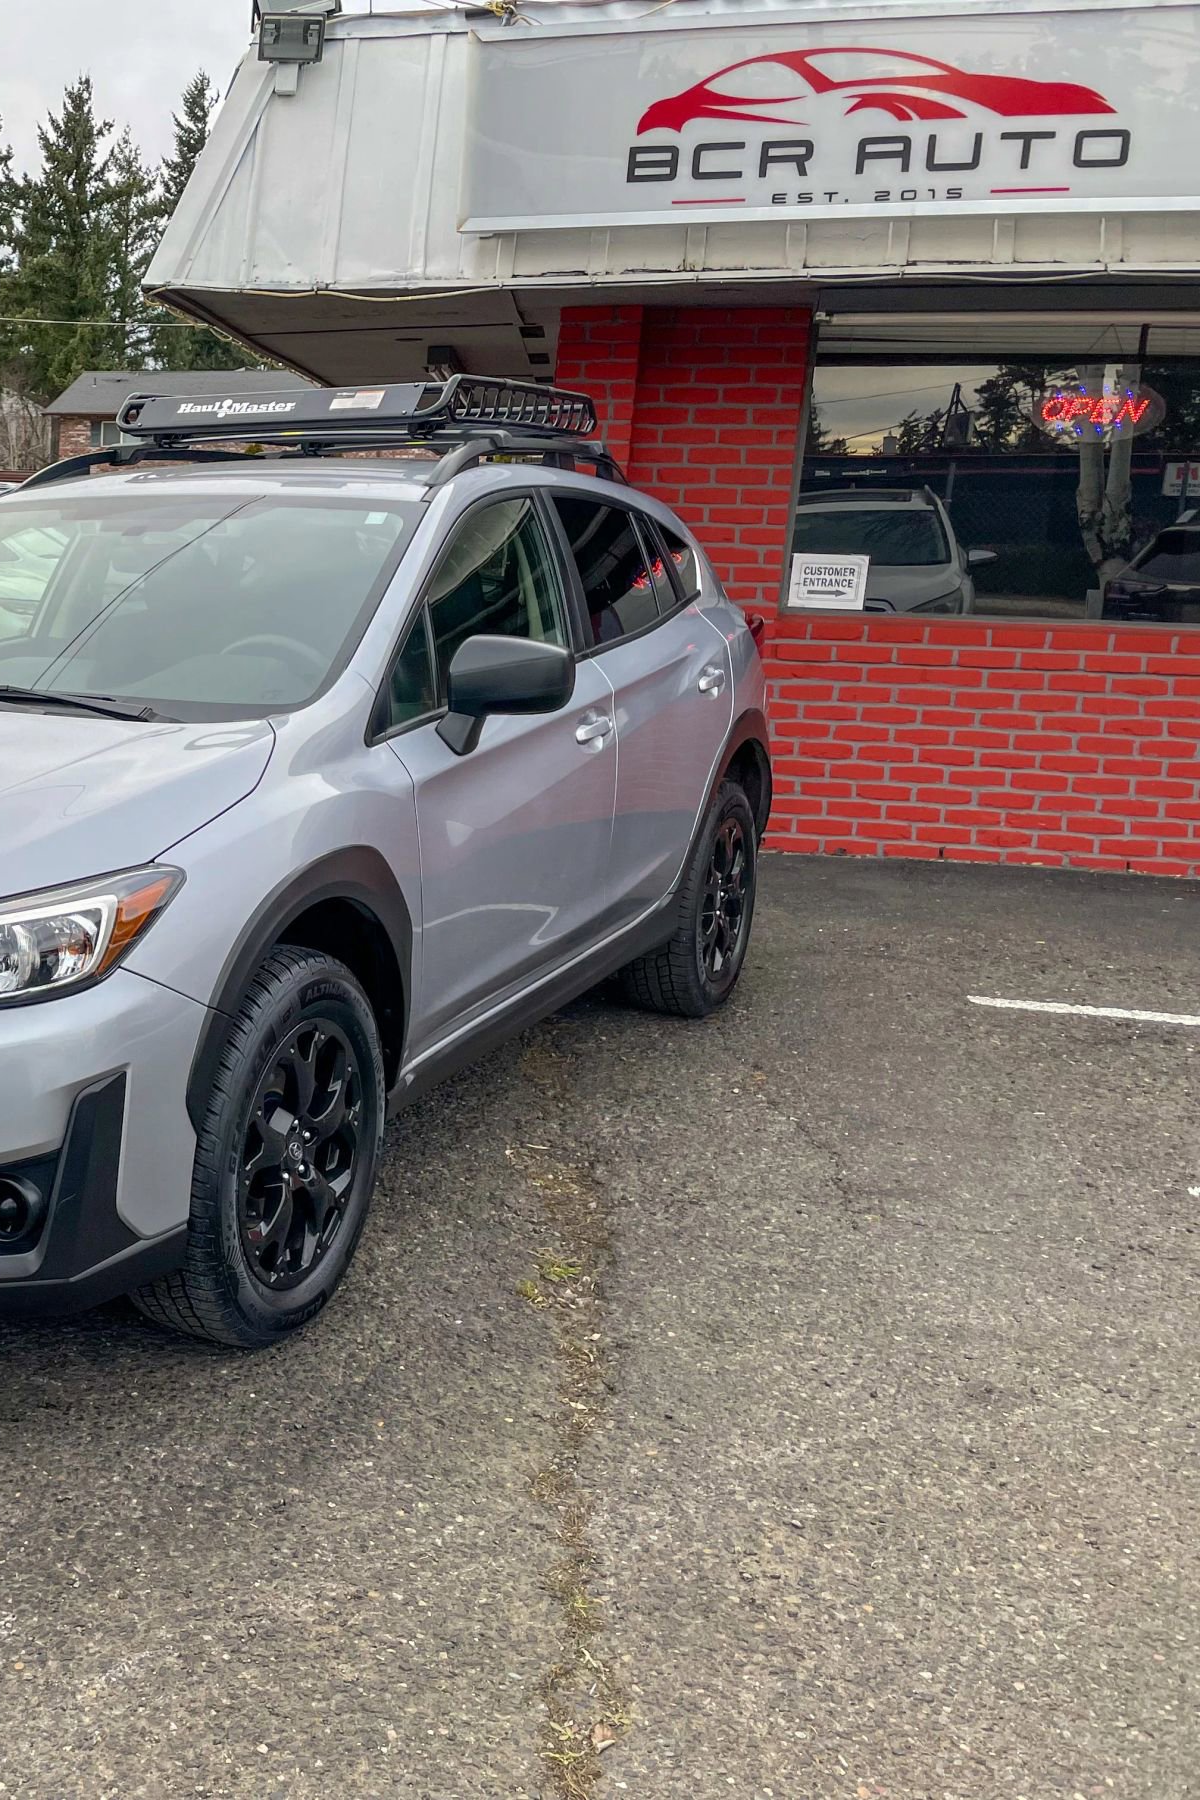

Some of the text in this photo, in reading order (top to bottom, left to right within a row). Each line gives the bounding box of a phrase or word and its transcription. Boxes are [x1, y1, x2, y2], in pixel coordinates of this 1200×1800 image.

[626, 129, 1132, 183] BCR AUTO
[771, 187, 963, 204] EST. 2015
[177, 401, 296, 415] Haul Master
[1041, 397, 1151, 424] OPEN
[803, 566, 856, 577] CUSTOMER
[802, 577, 854, 588] ENTRANCE
